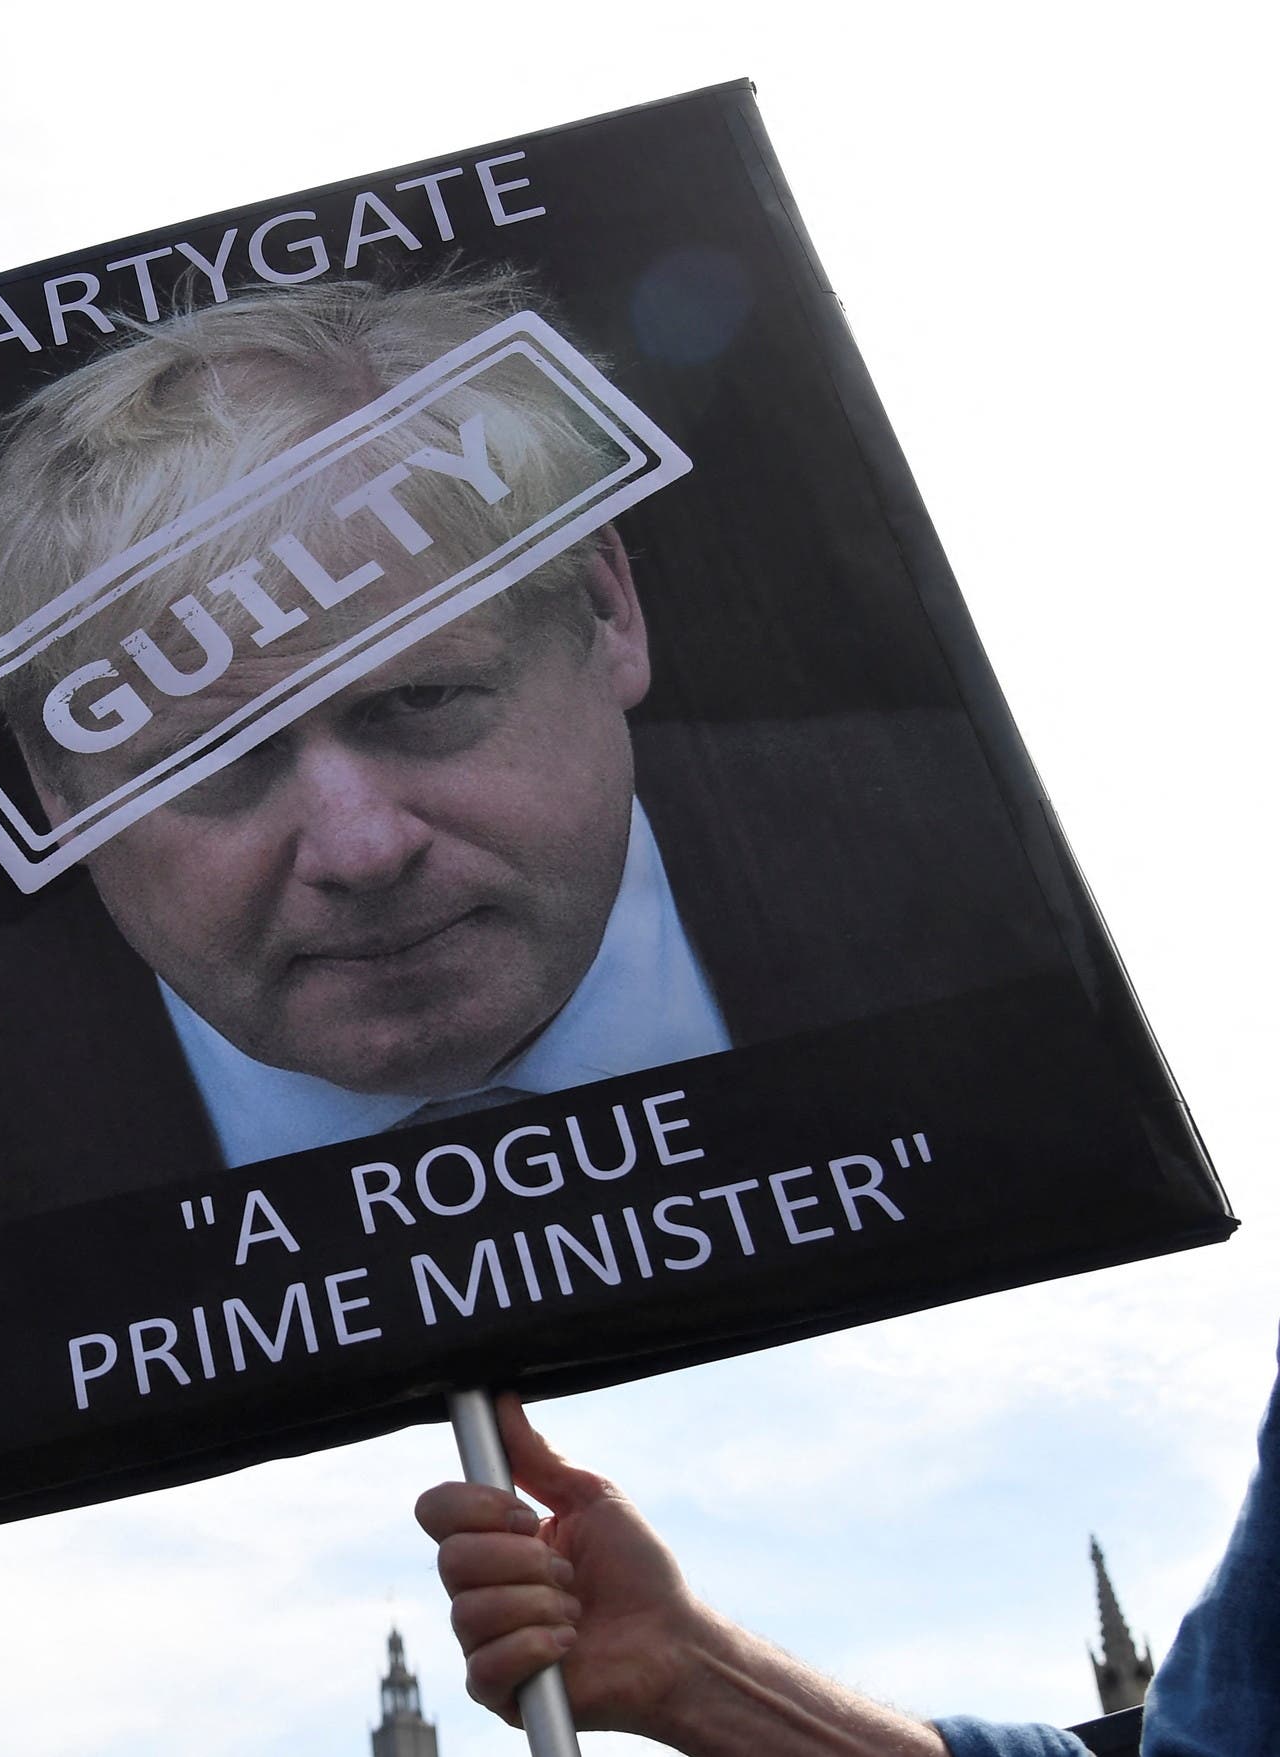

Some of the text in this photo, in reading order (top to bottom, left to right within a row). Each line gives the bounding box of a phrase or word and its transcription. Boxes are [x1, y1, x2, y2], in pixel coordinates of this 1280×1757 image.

[42, 413, 513, 755] GUILTY
[68, 1132, 933, 1410] PRIME MINISTER"
[180, 1090, 706, 1266] "A ROGUE
